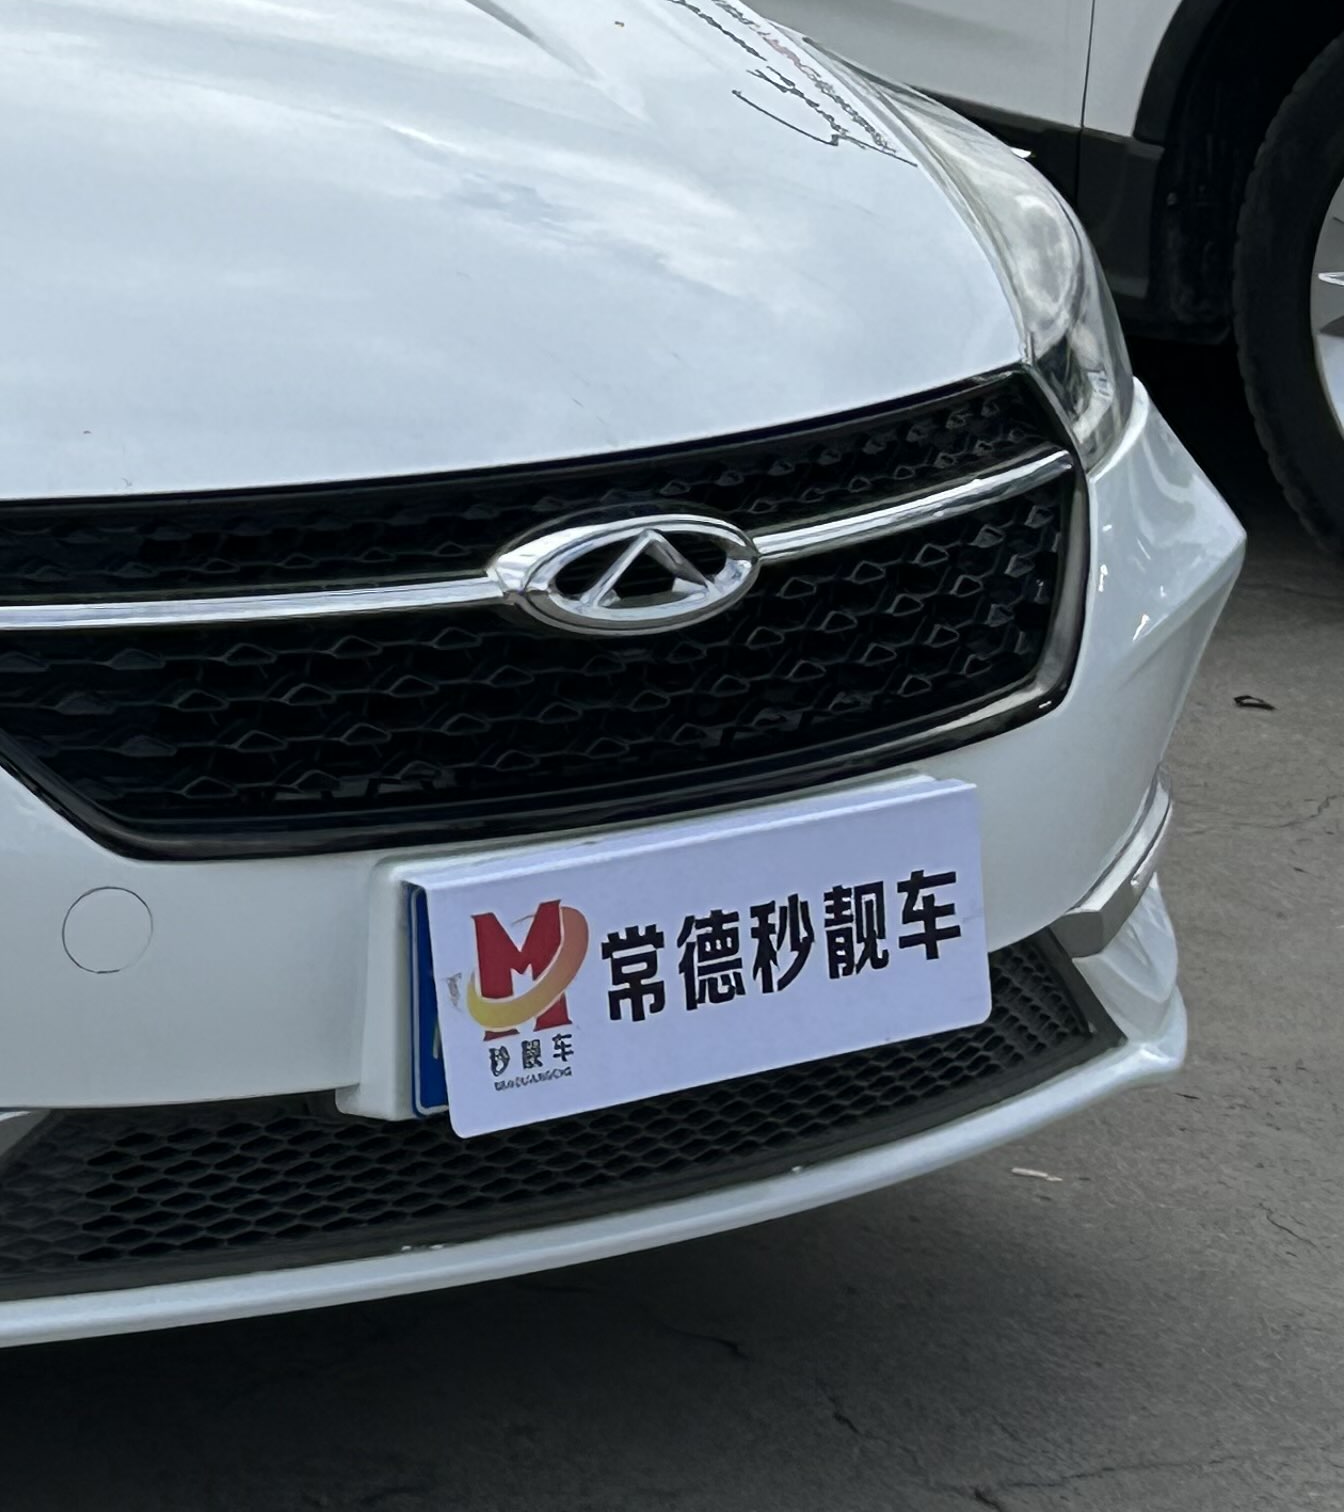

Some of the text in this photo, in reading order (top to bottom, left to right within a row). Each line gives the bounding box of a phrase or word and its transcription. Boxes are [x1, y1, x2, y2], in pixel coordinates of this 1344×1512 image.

[600, 869, 963, 1022] 常德秒靓车
